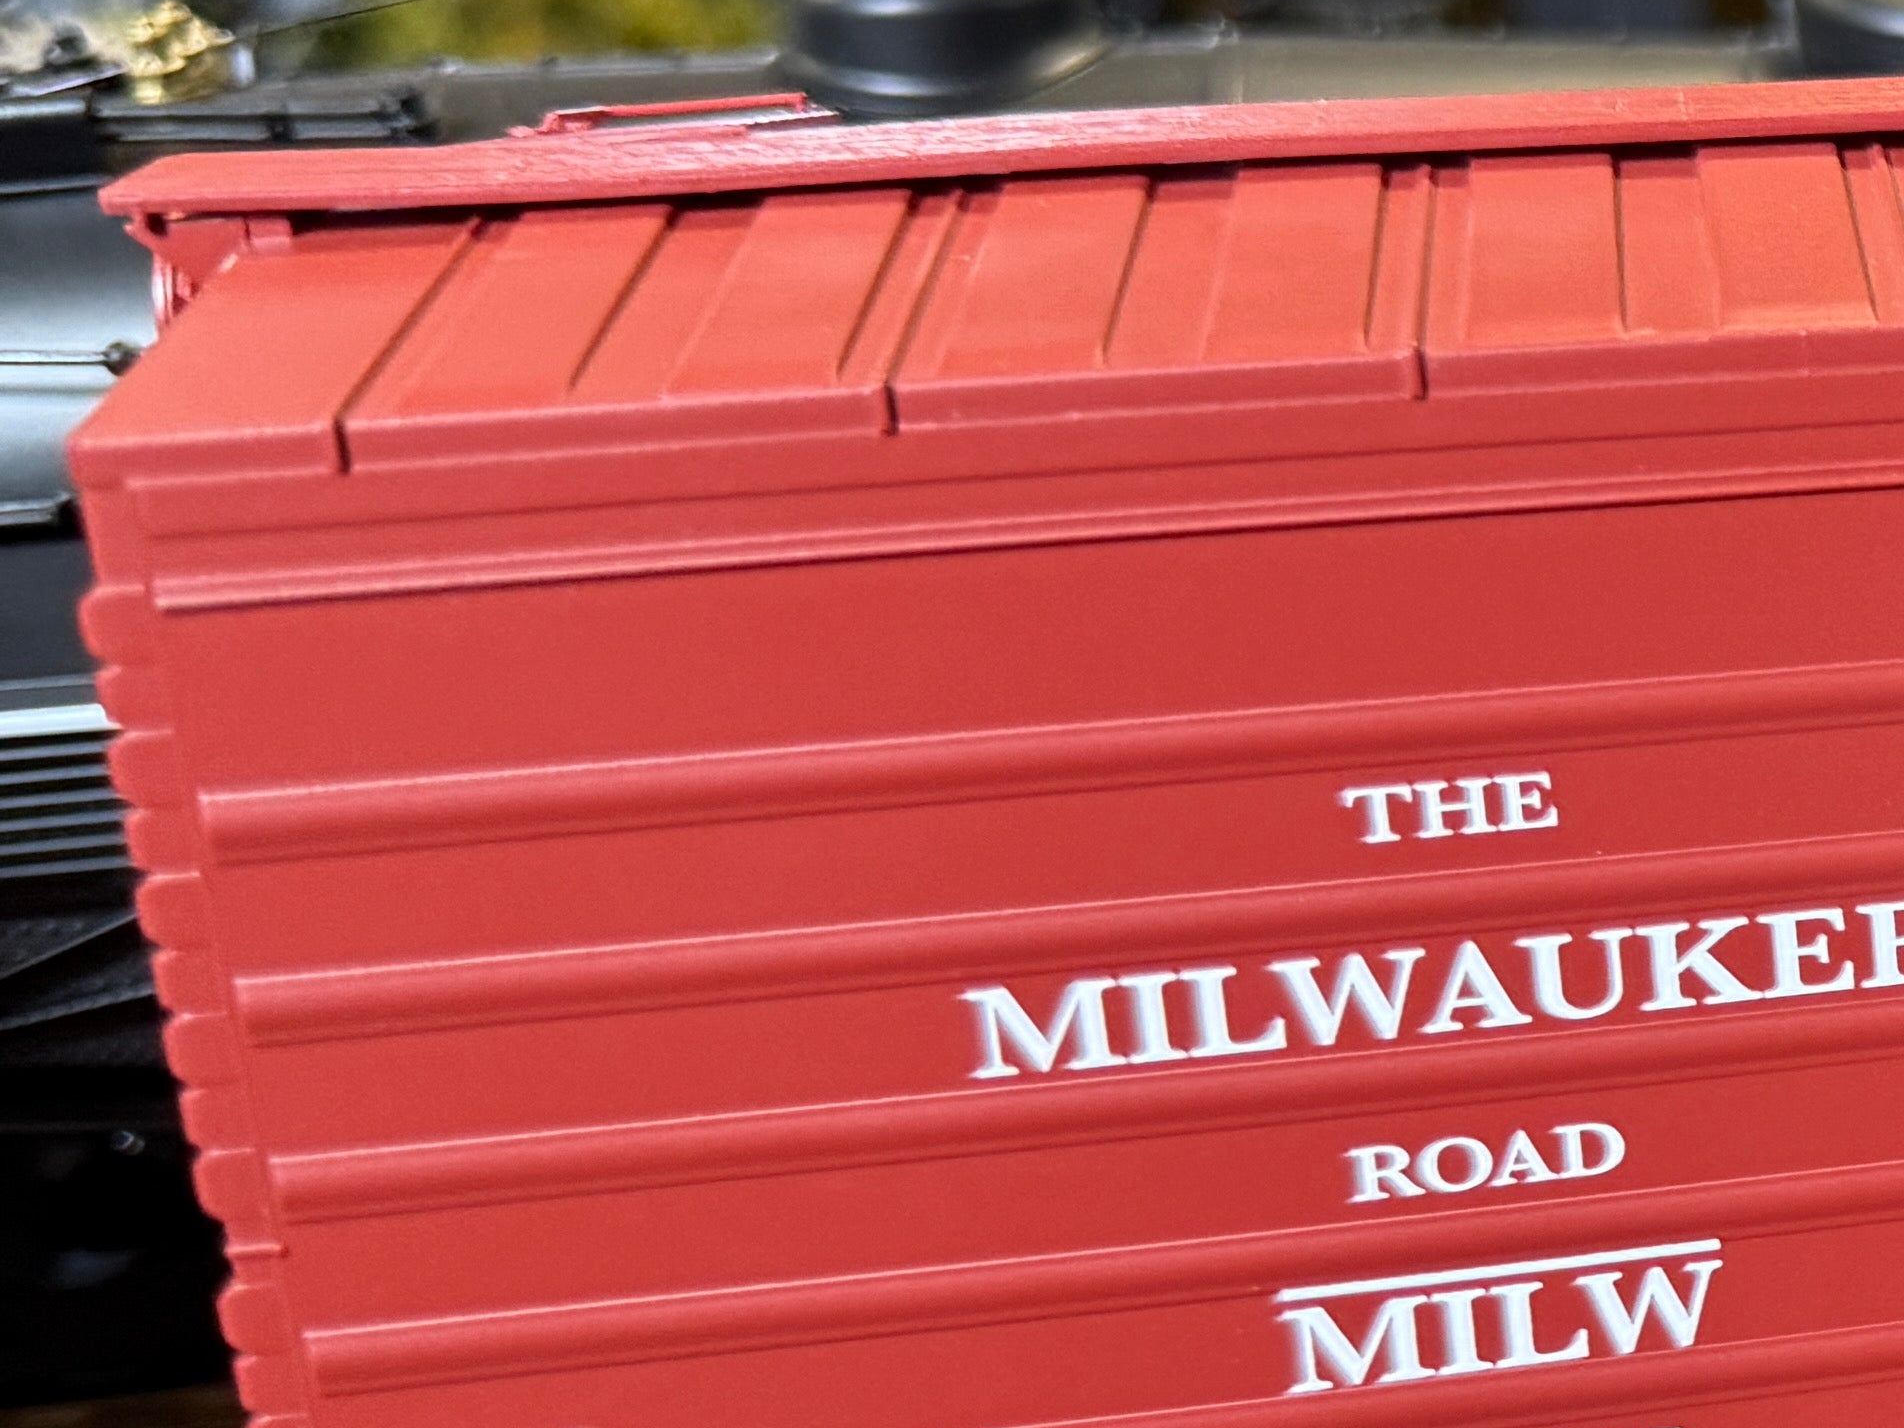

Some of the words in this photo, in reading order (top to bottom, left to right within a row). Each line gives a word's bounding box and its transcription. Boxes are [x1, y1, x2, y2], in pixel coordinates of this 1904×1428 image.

[1338, 771, 1559, 845] THE
[1344, 1122, 1626, 1203] ROAD
[1276, 1258, 1724, 1400] MILW
